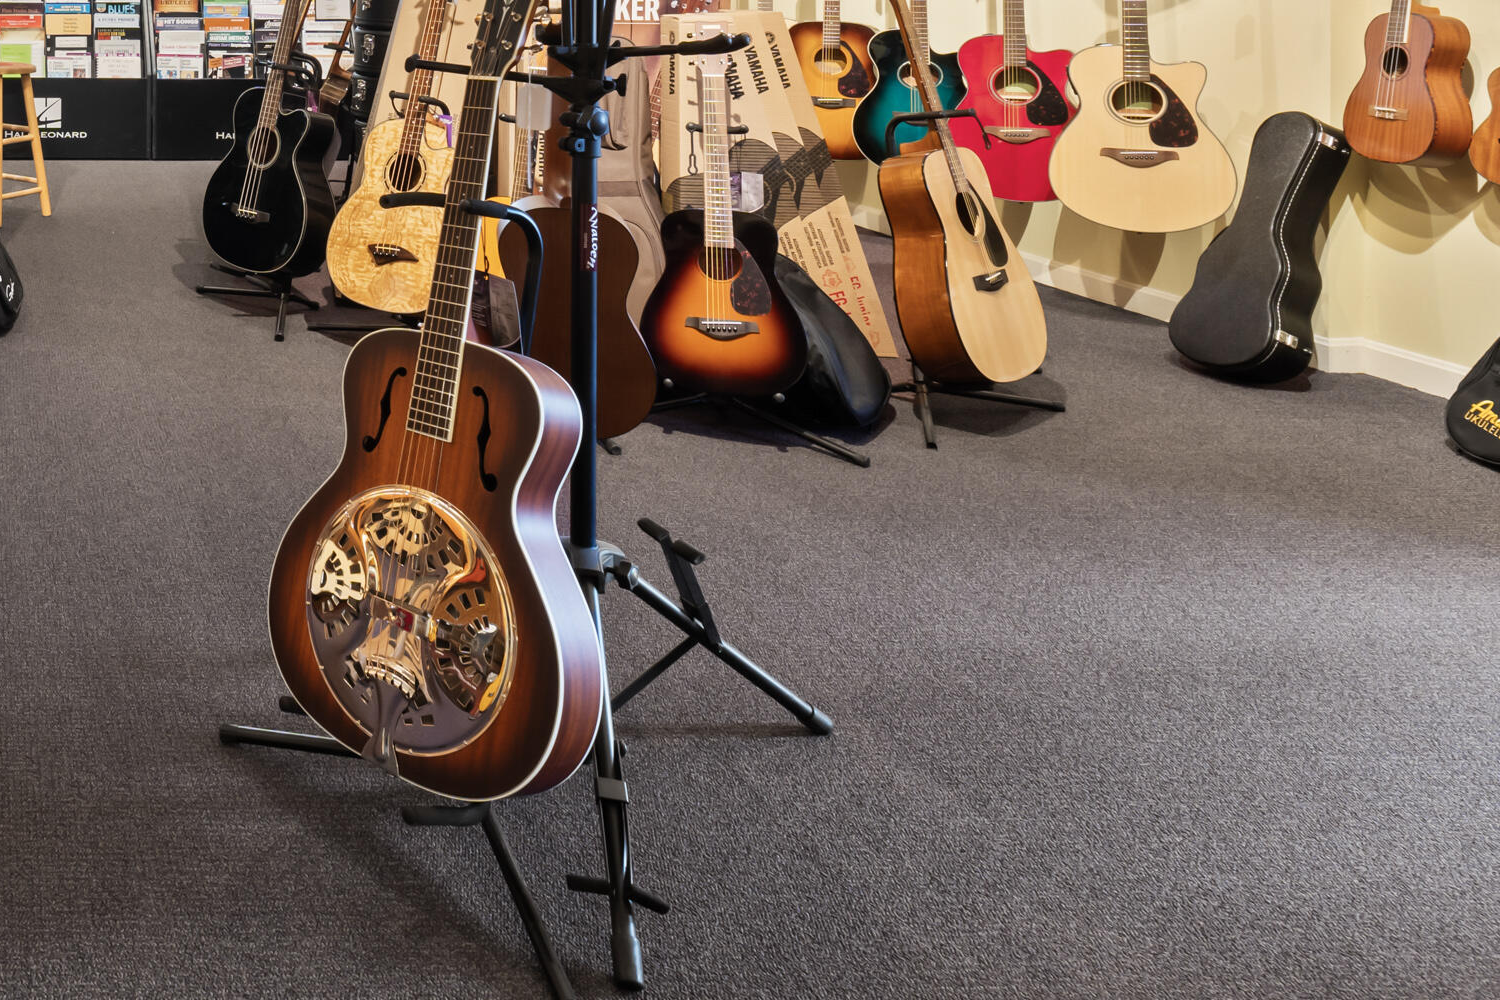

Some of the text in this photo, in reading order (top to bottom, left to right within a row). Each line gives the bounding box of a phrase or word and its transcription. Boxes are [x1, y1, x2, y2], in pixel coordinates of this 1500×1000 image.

[108, 4, 136, 14] BLUES
[725, 54, 745, 101] AMAHA
[744, 45, 769, 95] YAMAHA
[1464, 411, 1500, 439] UKULEL
